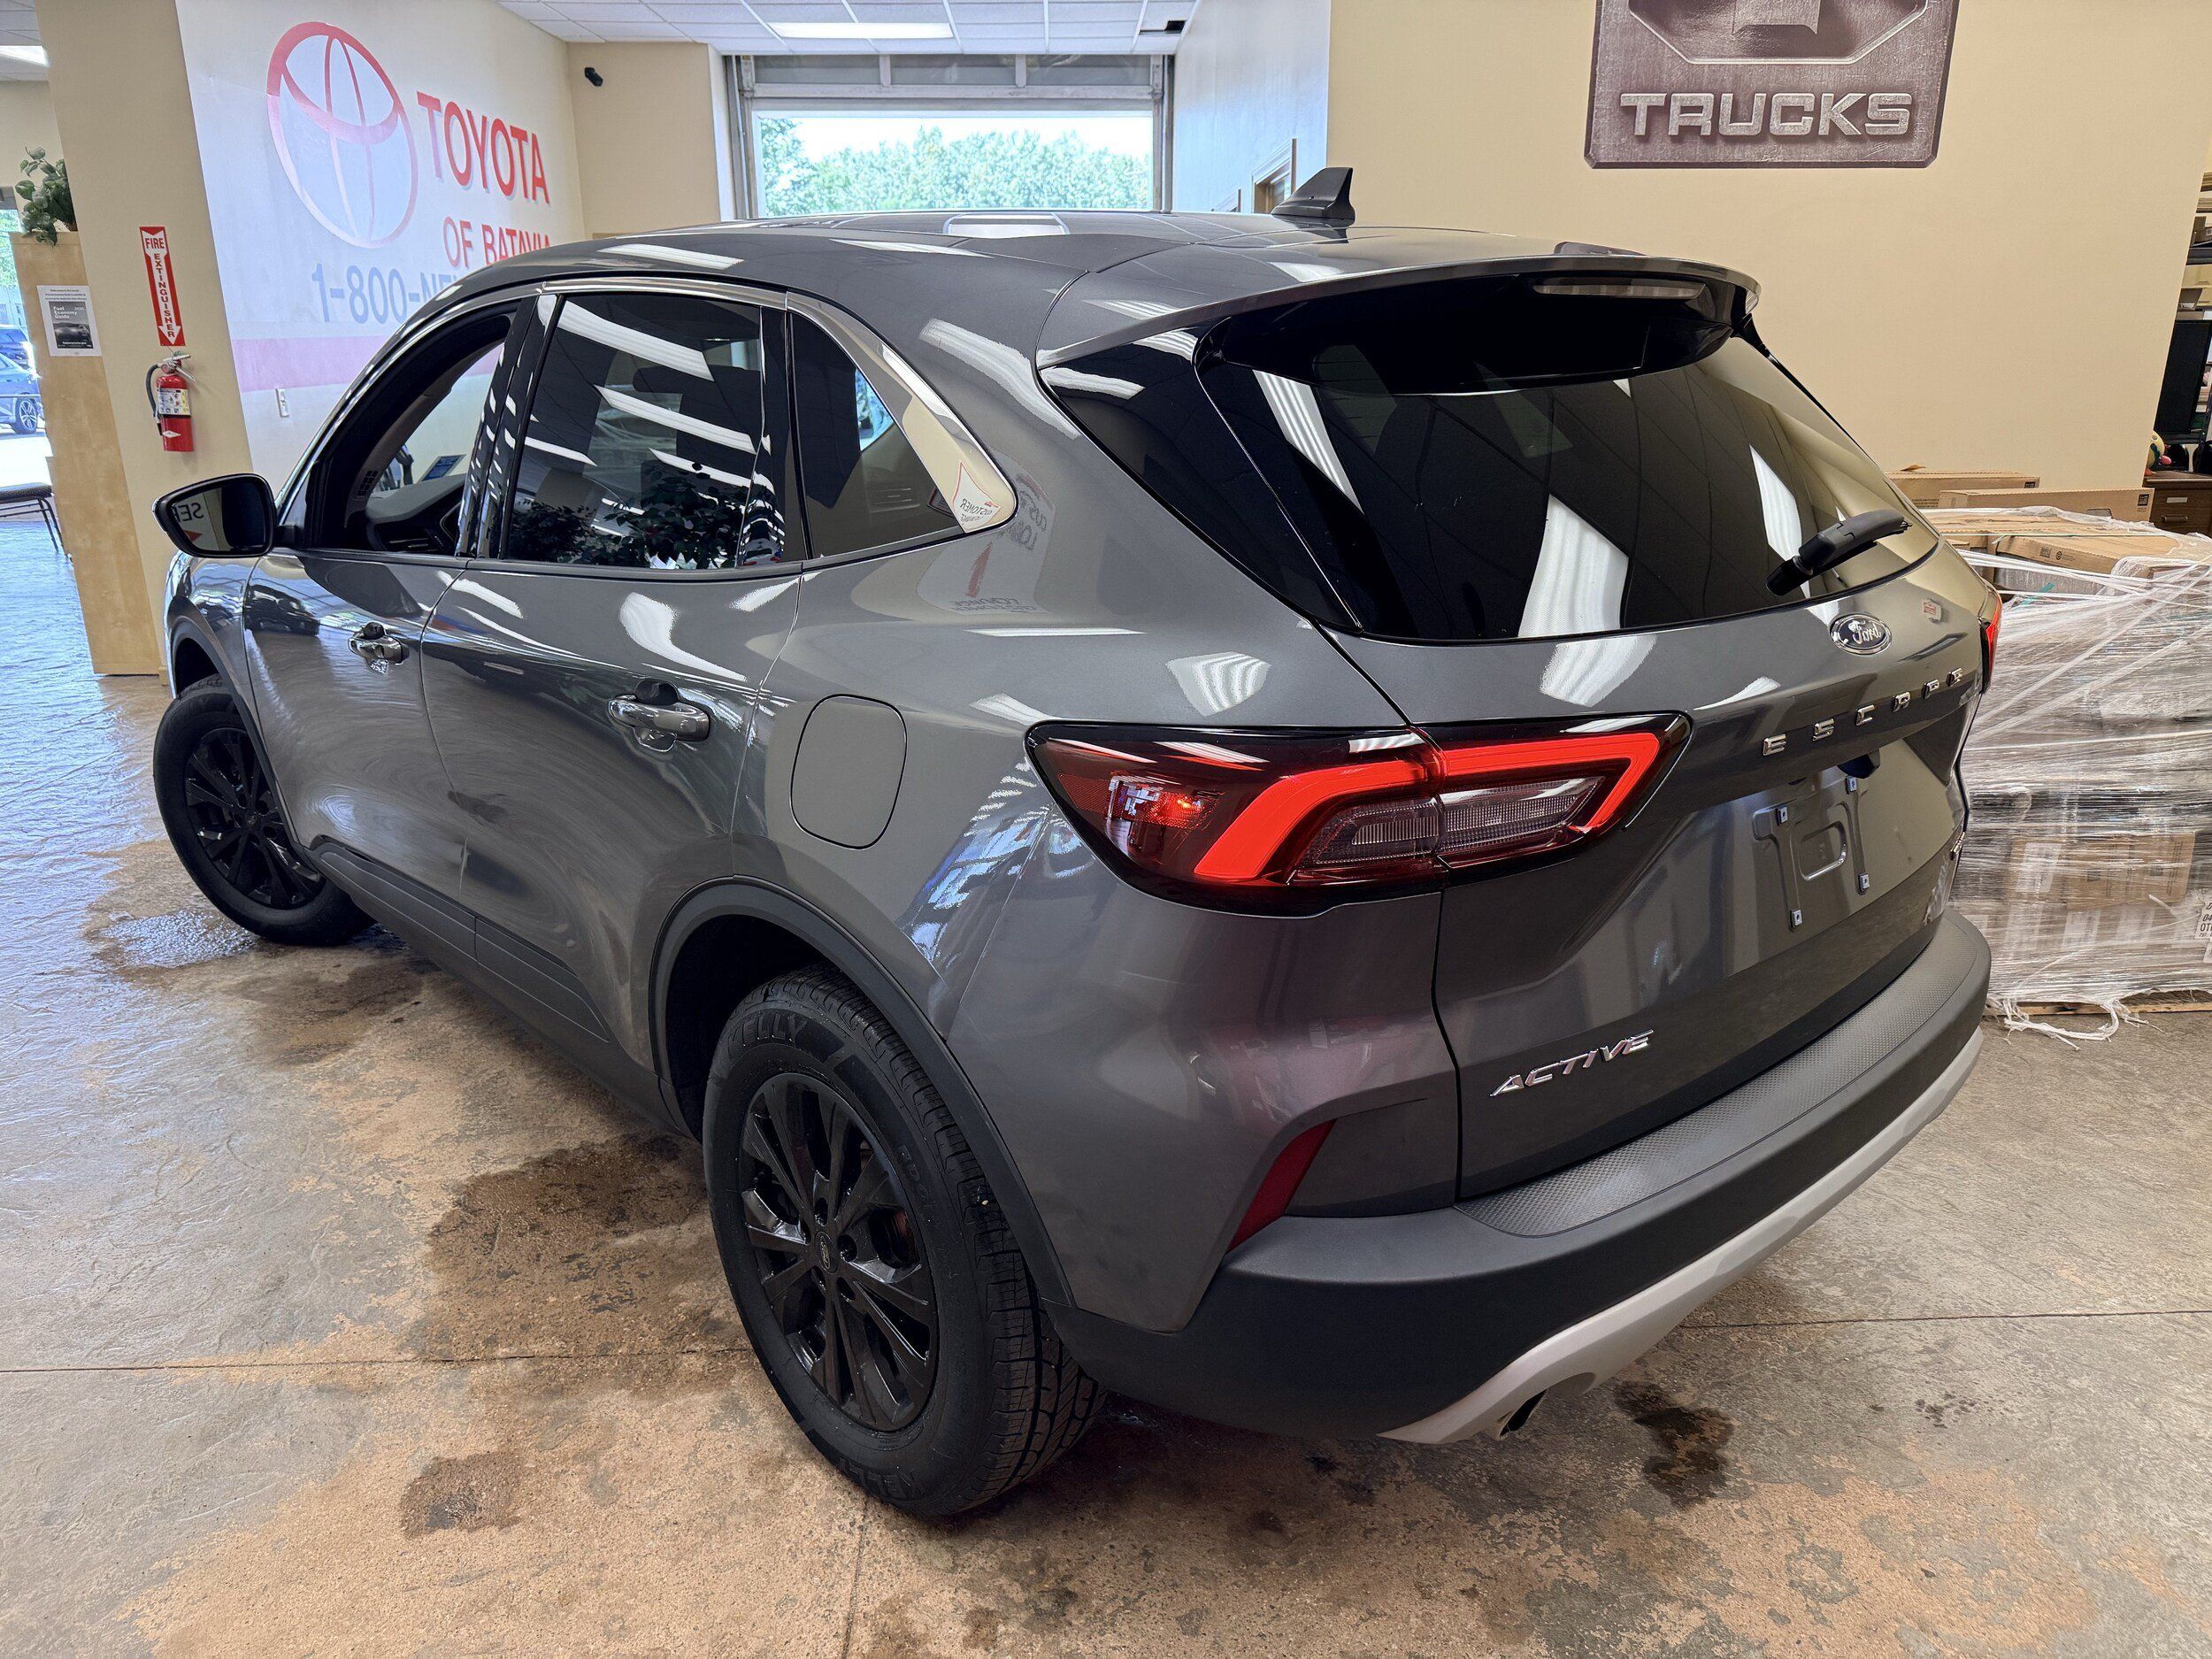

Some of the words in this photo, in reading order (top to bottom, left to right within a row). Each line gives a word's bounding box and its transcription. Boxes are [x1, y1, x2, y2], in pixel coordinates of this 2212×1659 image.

[416, 90, 550, 204] TOYOTA
[1620, 93, 1913, 137] TRUCKS
[145, 237, 165, 249] FIRE
[443, 216, 472, 270] OF
[153, 253, 175, 337] EXTINGUISHER
[1763, 668, 1963, 757] ESCAPE
[1489, 1029, 1655, 1097] ACTIVE
